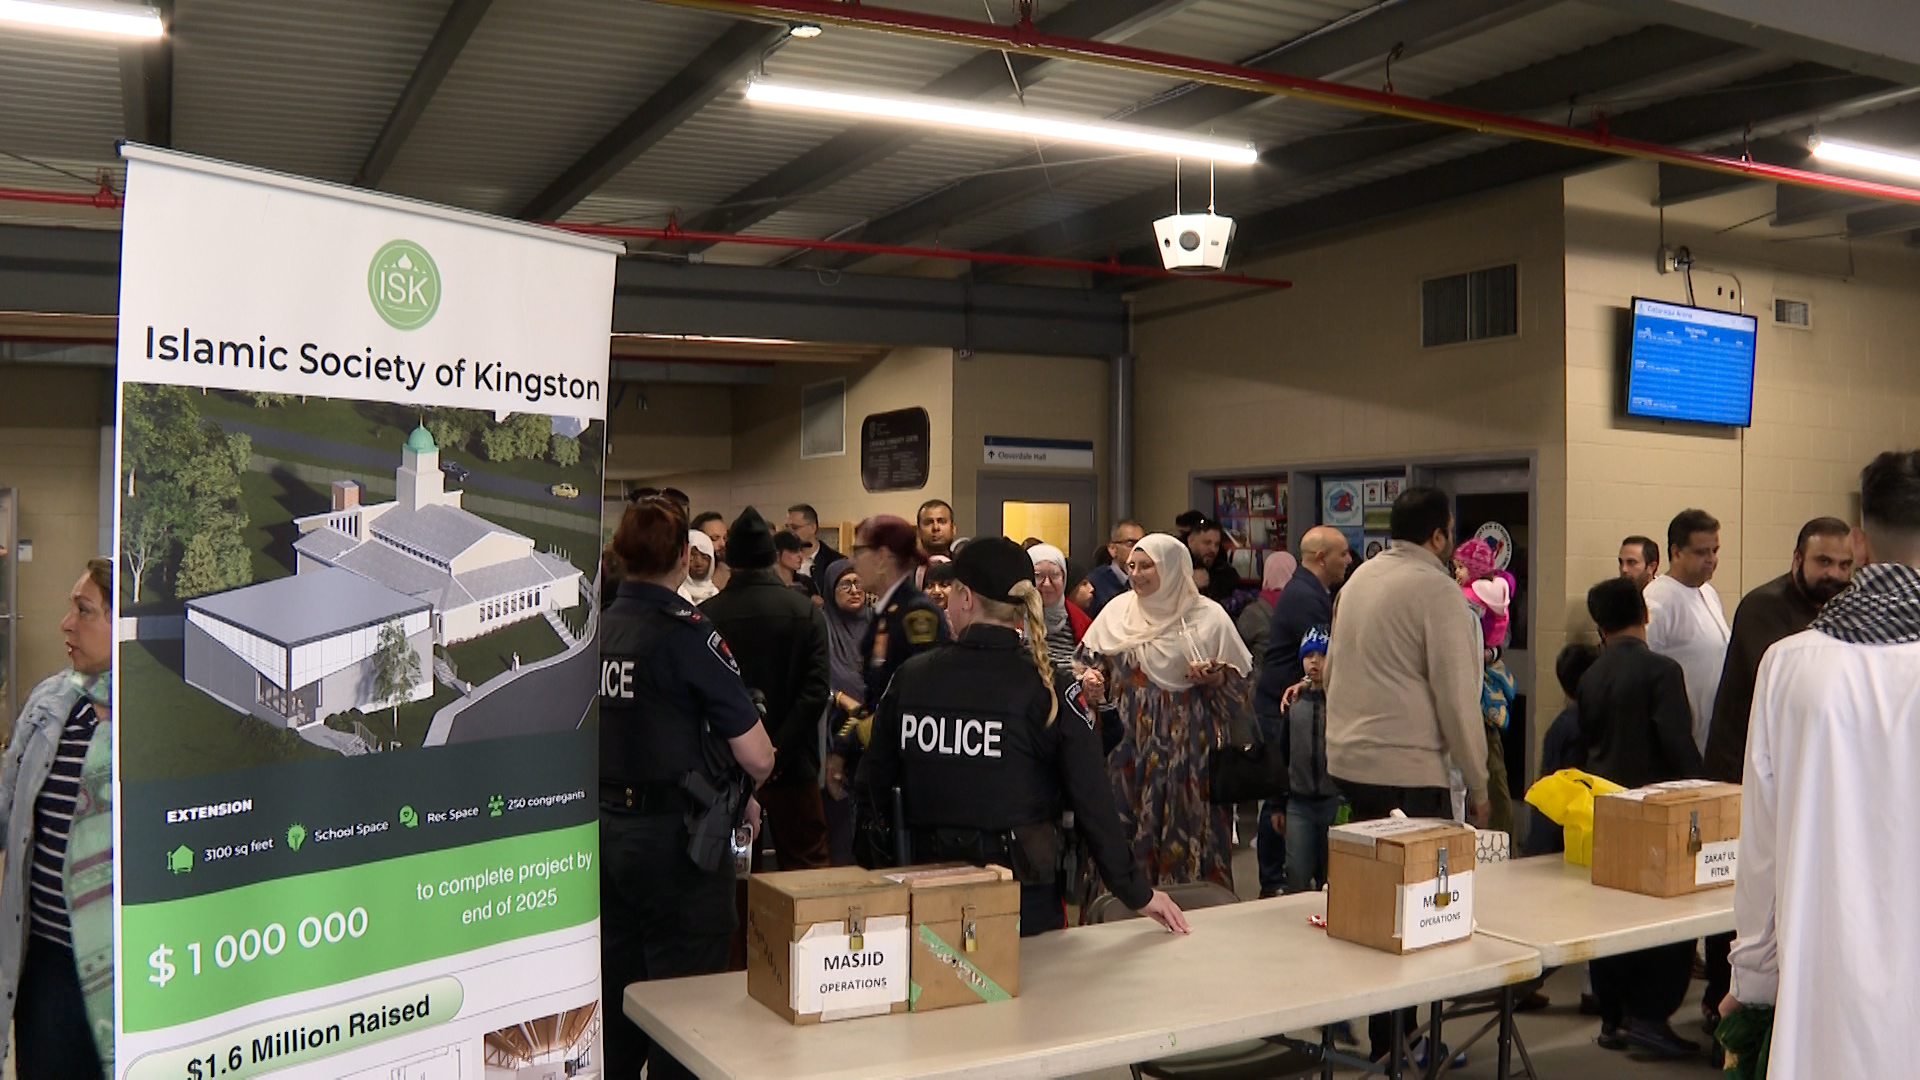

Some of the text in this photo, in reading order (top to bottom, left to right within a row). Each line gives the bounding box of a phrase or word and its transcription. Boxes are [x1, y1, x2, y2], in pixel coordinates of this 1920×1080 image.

[380, 269, 428, 307] ISK
[146, 325, 601, 401] Islamic Society of Kingston
[998, 451, 1032, 460] Cloverdale
[900, 712, 1003, 758] POLICE
[166, 799, 253, 824] EXTENSION
[507, 797, 526, 810] 250
[426, 806, 480, 824] Rec Space
[314, 821, 390, 842] School Space
[204, 838, 275, 862] 3100 sq feet
[1704, 852, 1727, 865] ZAKAT
[416, 851, 593, 900] to complete project by
[1710, 865, 1730, 878] FITER
[462, 887, 558, 925] end of 2025
[1419, 912, 1461, 928] OPERATIONS
[147, 905, 369, 988] $ 1 000 000
[823, 951, 885, 972] MASJID
[819, 977, 888, 995] OPERATIONS
[187, 993, 430, 1080] $1.6 Million Raised
